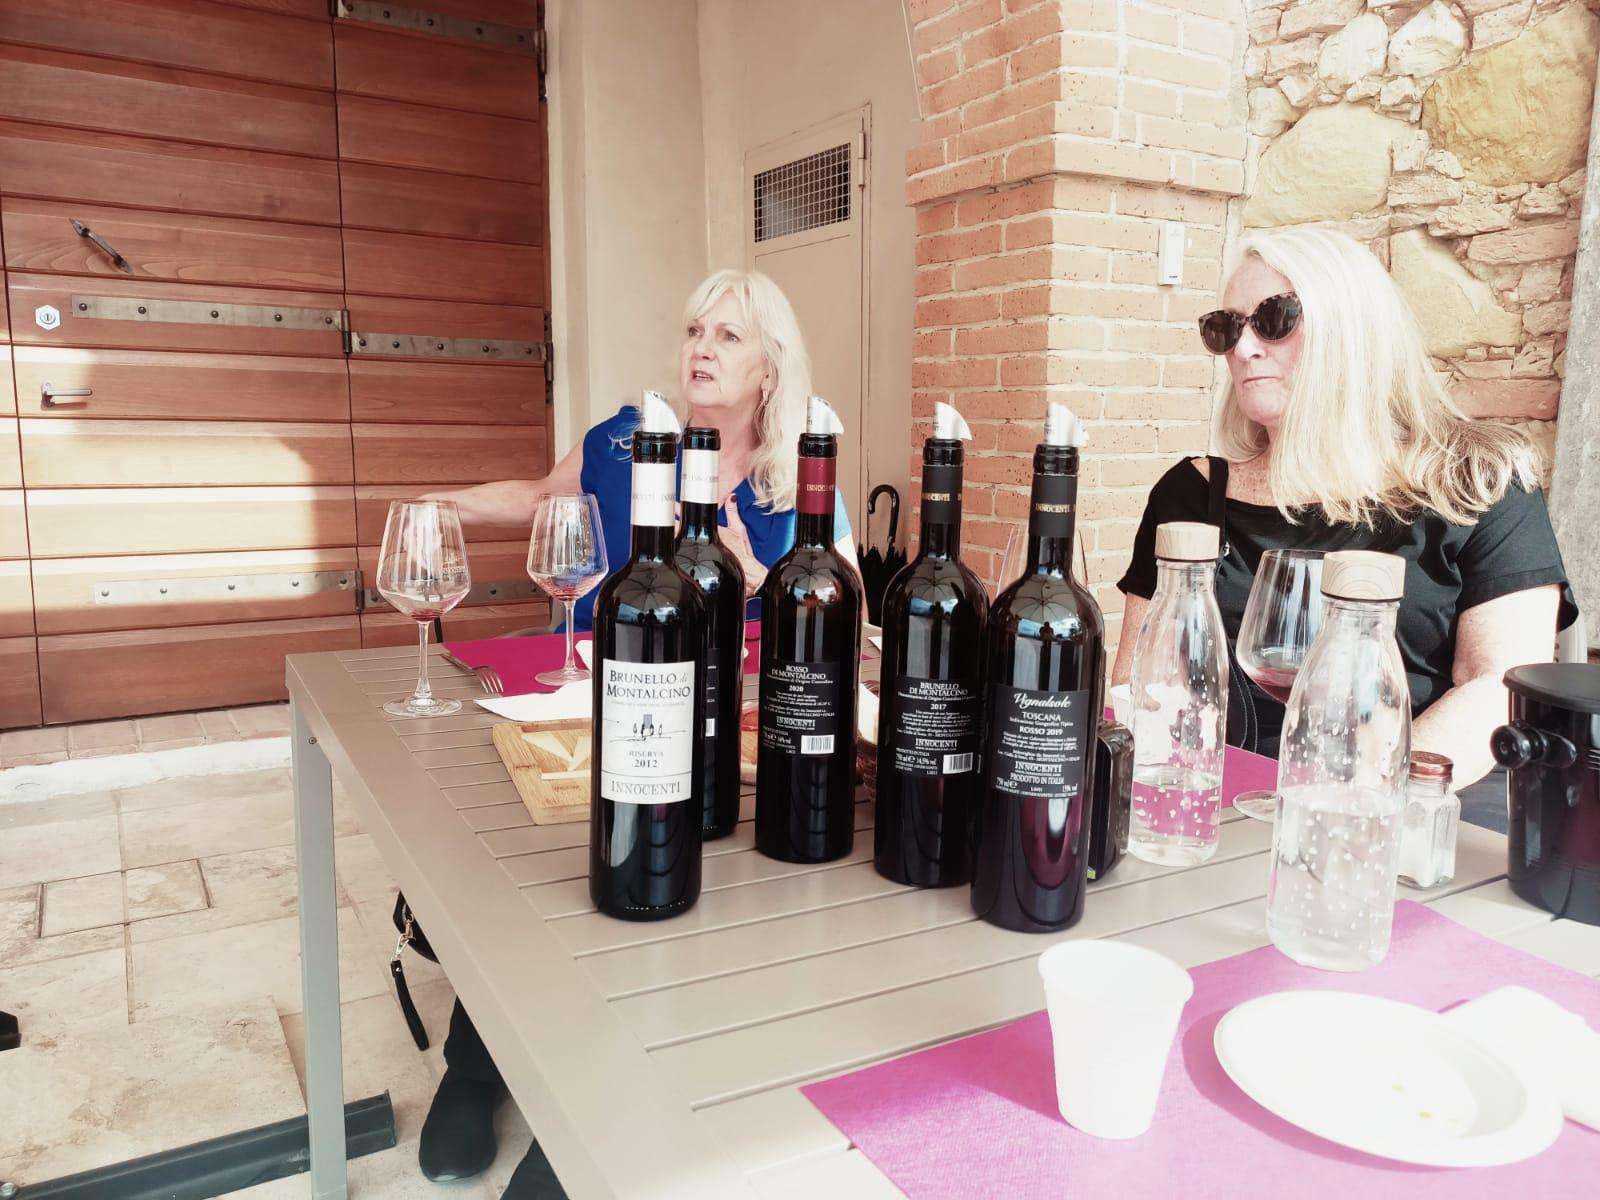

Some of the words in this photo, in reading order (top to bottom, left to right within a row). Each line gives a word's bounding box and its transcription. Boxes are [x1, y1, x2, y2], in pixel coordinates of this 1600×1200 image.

[785, 665, 808, 673] ROSSO
[610, 669, 677, 684] BRUNELLO
[778, 670, 826, 680] MONTALCINO
[607, 683, 691, 698] MONTALCINO
[920, 681, 959, 690] BRUNELLO
[918, 688, 968, 697] MONTALCINO
[776, 715, 816, 727] INNOCENTI
[1021, 711, 1061, 722] TOSCANA
[1019, 725, 1045, 735] ROSSO
[1046, 728, 1063, 736] 2019
[915, 738, 958, 748] INNOCENTI
[634, 759, 658, 768] 2012
[1015, 761, 1062, 773] INNOCENTI
[611, 780, 680, 795] INNOCENTI
